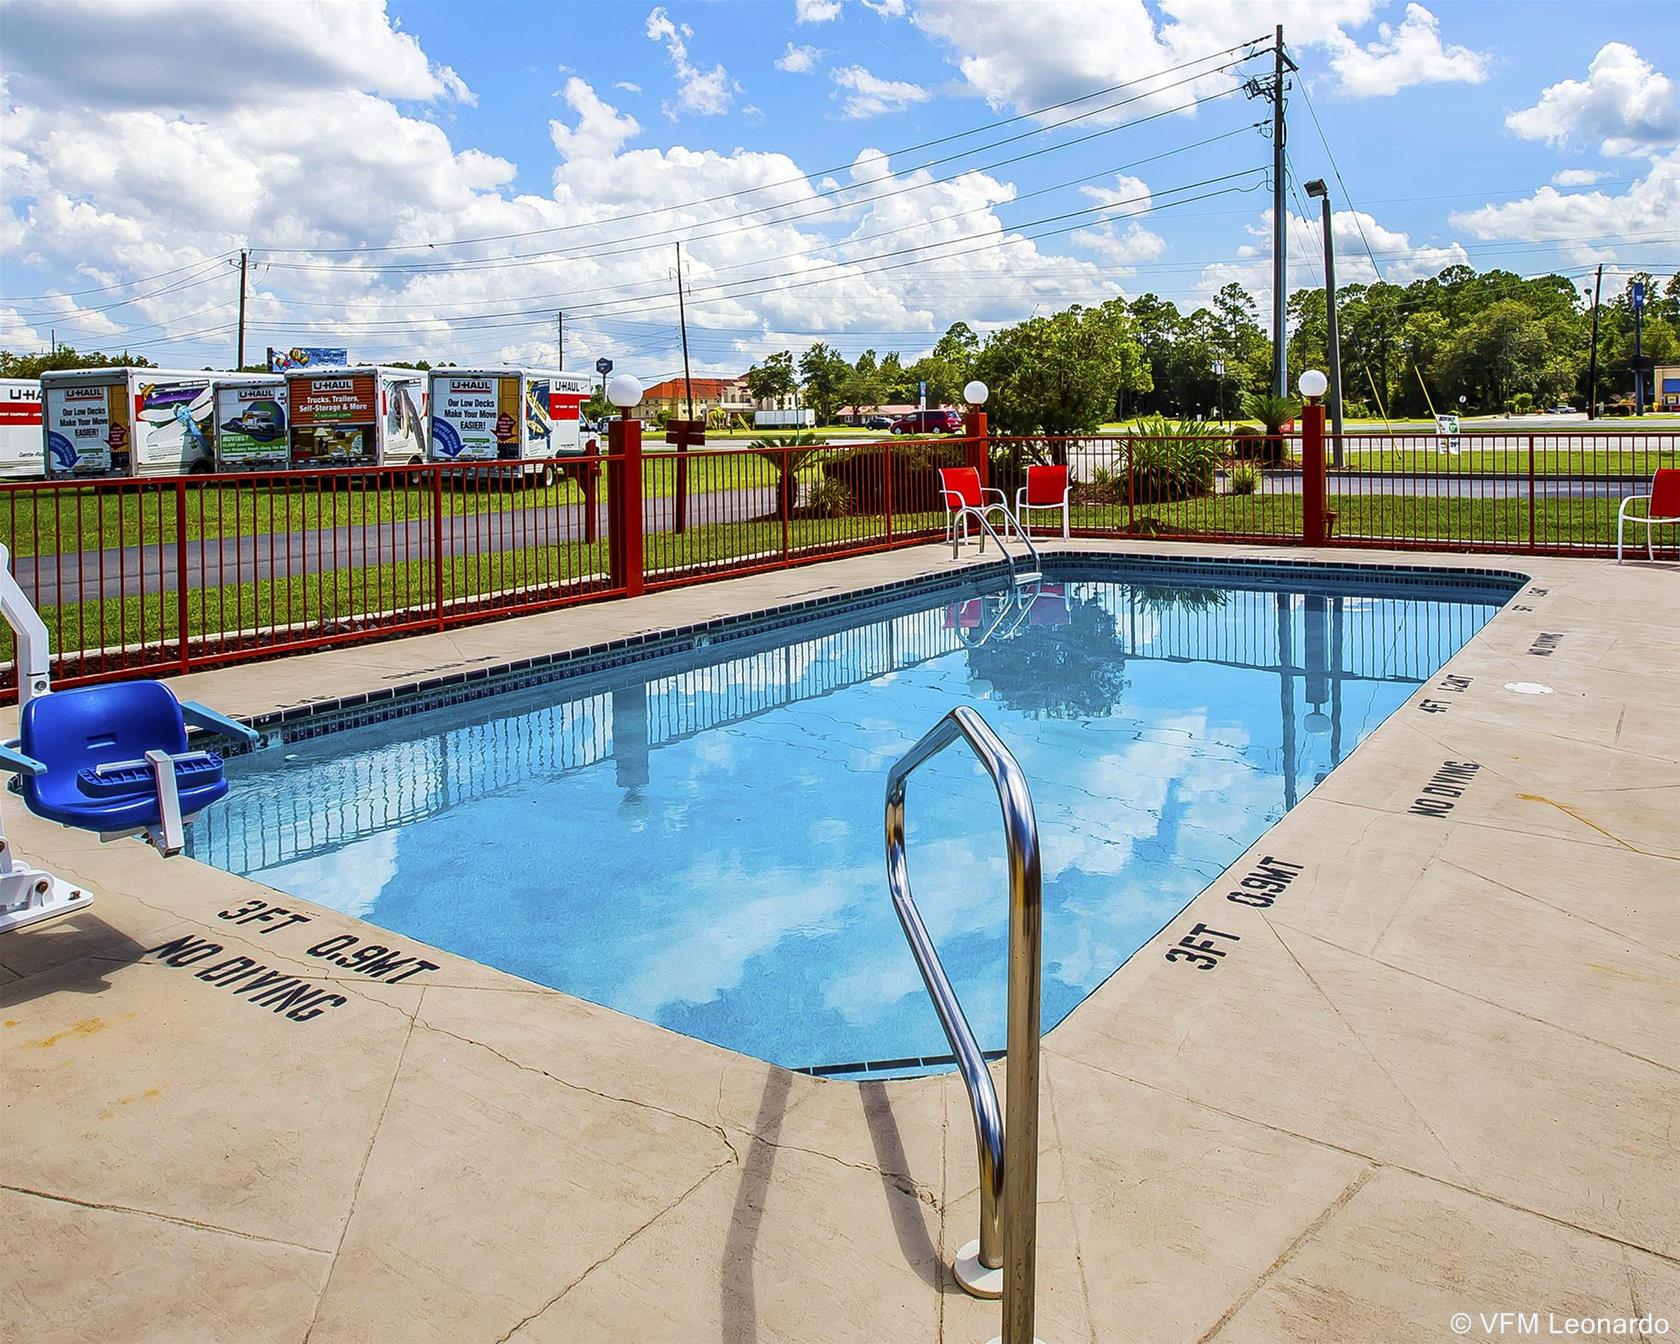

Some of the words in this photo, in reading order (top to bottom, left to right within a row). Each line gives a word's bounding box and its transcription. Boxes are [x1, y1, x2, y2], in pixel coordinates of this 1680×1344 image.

[313, 381, 352, 389] U-HAUL
[451, 381, 490, 389] U-HAUL
[555, 381, 579, 391] U-HAUL
[9, 389, 43, 400] U-HA
[448, 399, 459, 407] Our
[460, 399, 473, 407] Low
[474, 399, 495, 407] Decks
[62, 408, 73, 416] Our
[87, 407, 105, 415] Decks
[299, 404, 341, 412] Self-Storage
[444, 409, 463, 418] Make
[463, 409, 478, 418] Your
[479, 410, 497, 418] Move
[60, 418, 76, 426] Make
[92, 417, 108, 425] Move
[460, 421, 486, 430] EASIER!
[75, 428, 99, 437] EASIER!
[1422, 761, 1480, 798] DIVING
[1407, 798, 1455, 818] NO
[1165, 923, 1240, 970] 3FT
[1226, 856, 1304, 908] 0.9MT
[217, 900, 311, 934] 3FT
[306, 935, 440, 984] 0.9MT
[150, 934, 223, 967] NO
[193, 956, 347, 1022] DIVING
